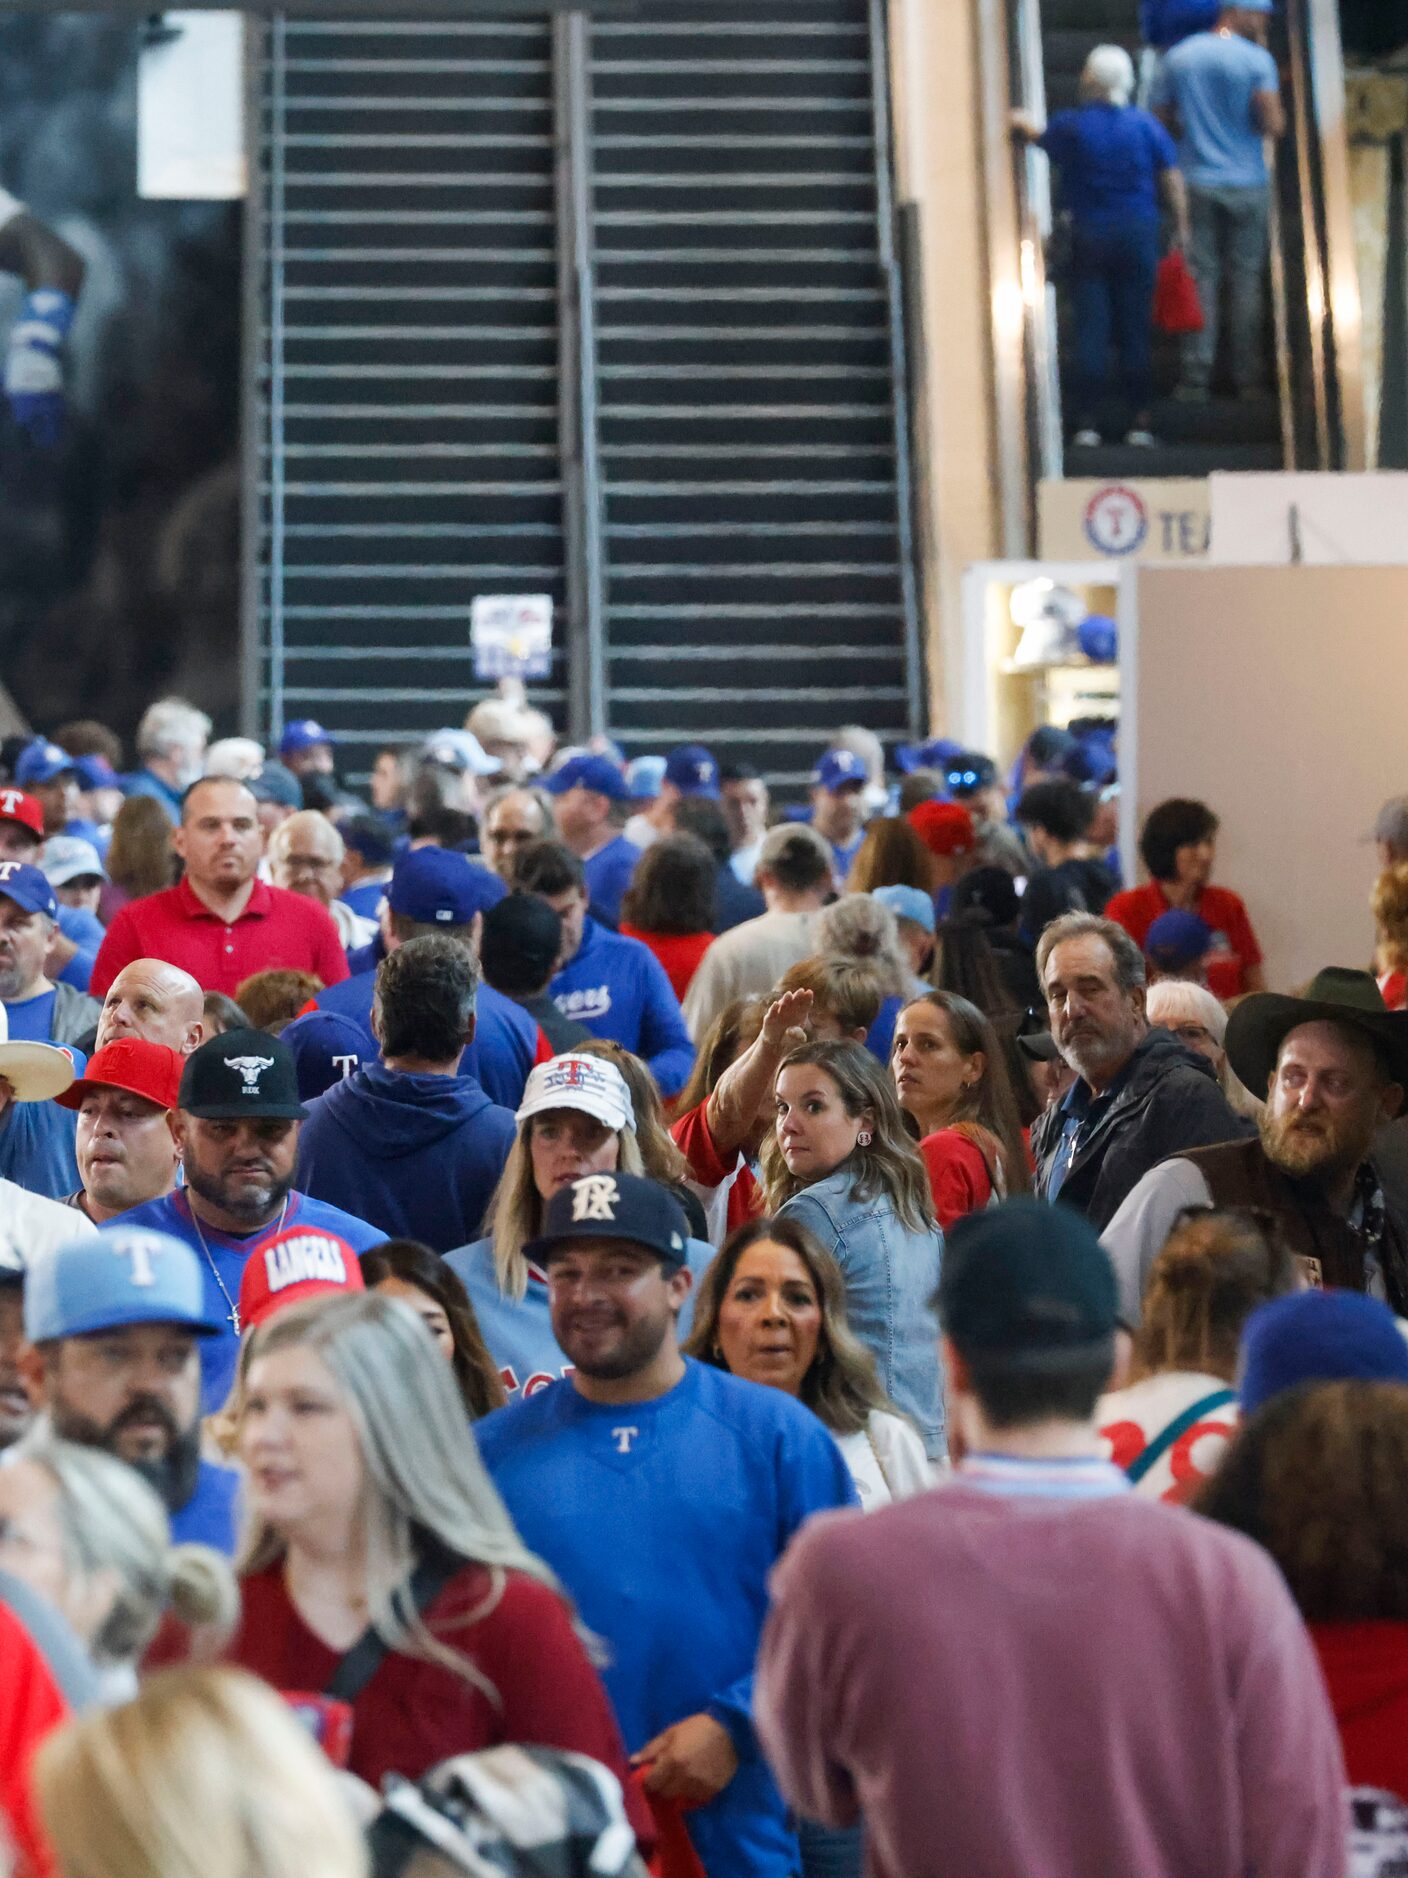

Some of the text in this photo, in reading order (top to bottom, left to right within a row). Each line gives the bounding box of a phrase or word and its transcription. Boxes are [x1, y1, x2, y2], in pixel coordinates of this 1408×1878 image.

[0, 790, 24, 813] T
[332, 1054, 358, 1079] T
[113, 1233, 163, 1287] T
[611, 1425, 639, 1454] T
